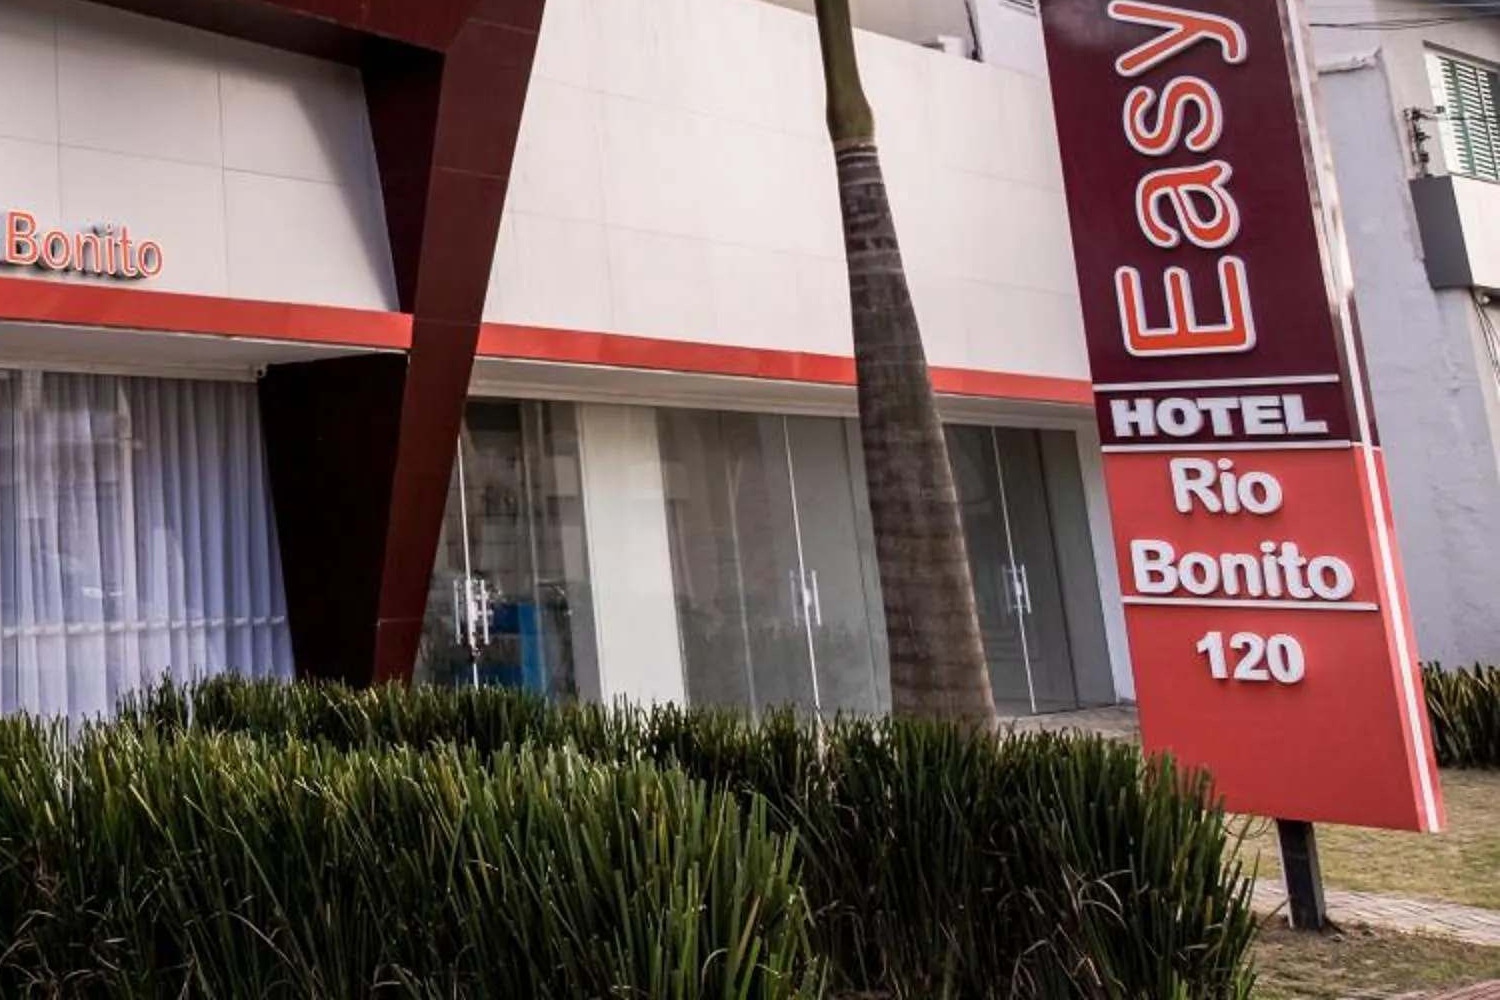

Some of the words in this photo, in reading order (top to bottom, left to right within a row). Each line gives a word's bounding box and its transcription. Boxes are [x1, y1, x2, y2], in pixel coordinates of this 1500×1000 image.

[1110, 394, 1328, 438] HOTEL
[1169, 456, 1284, 516] Rio
[1129, 538, 1355, 601] Bonito
[1195, 630, 1306, 686] 120
